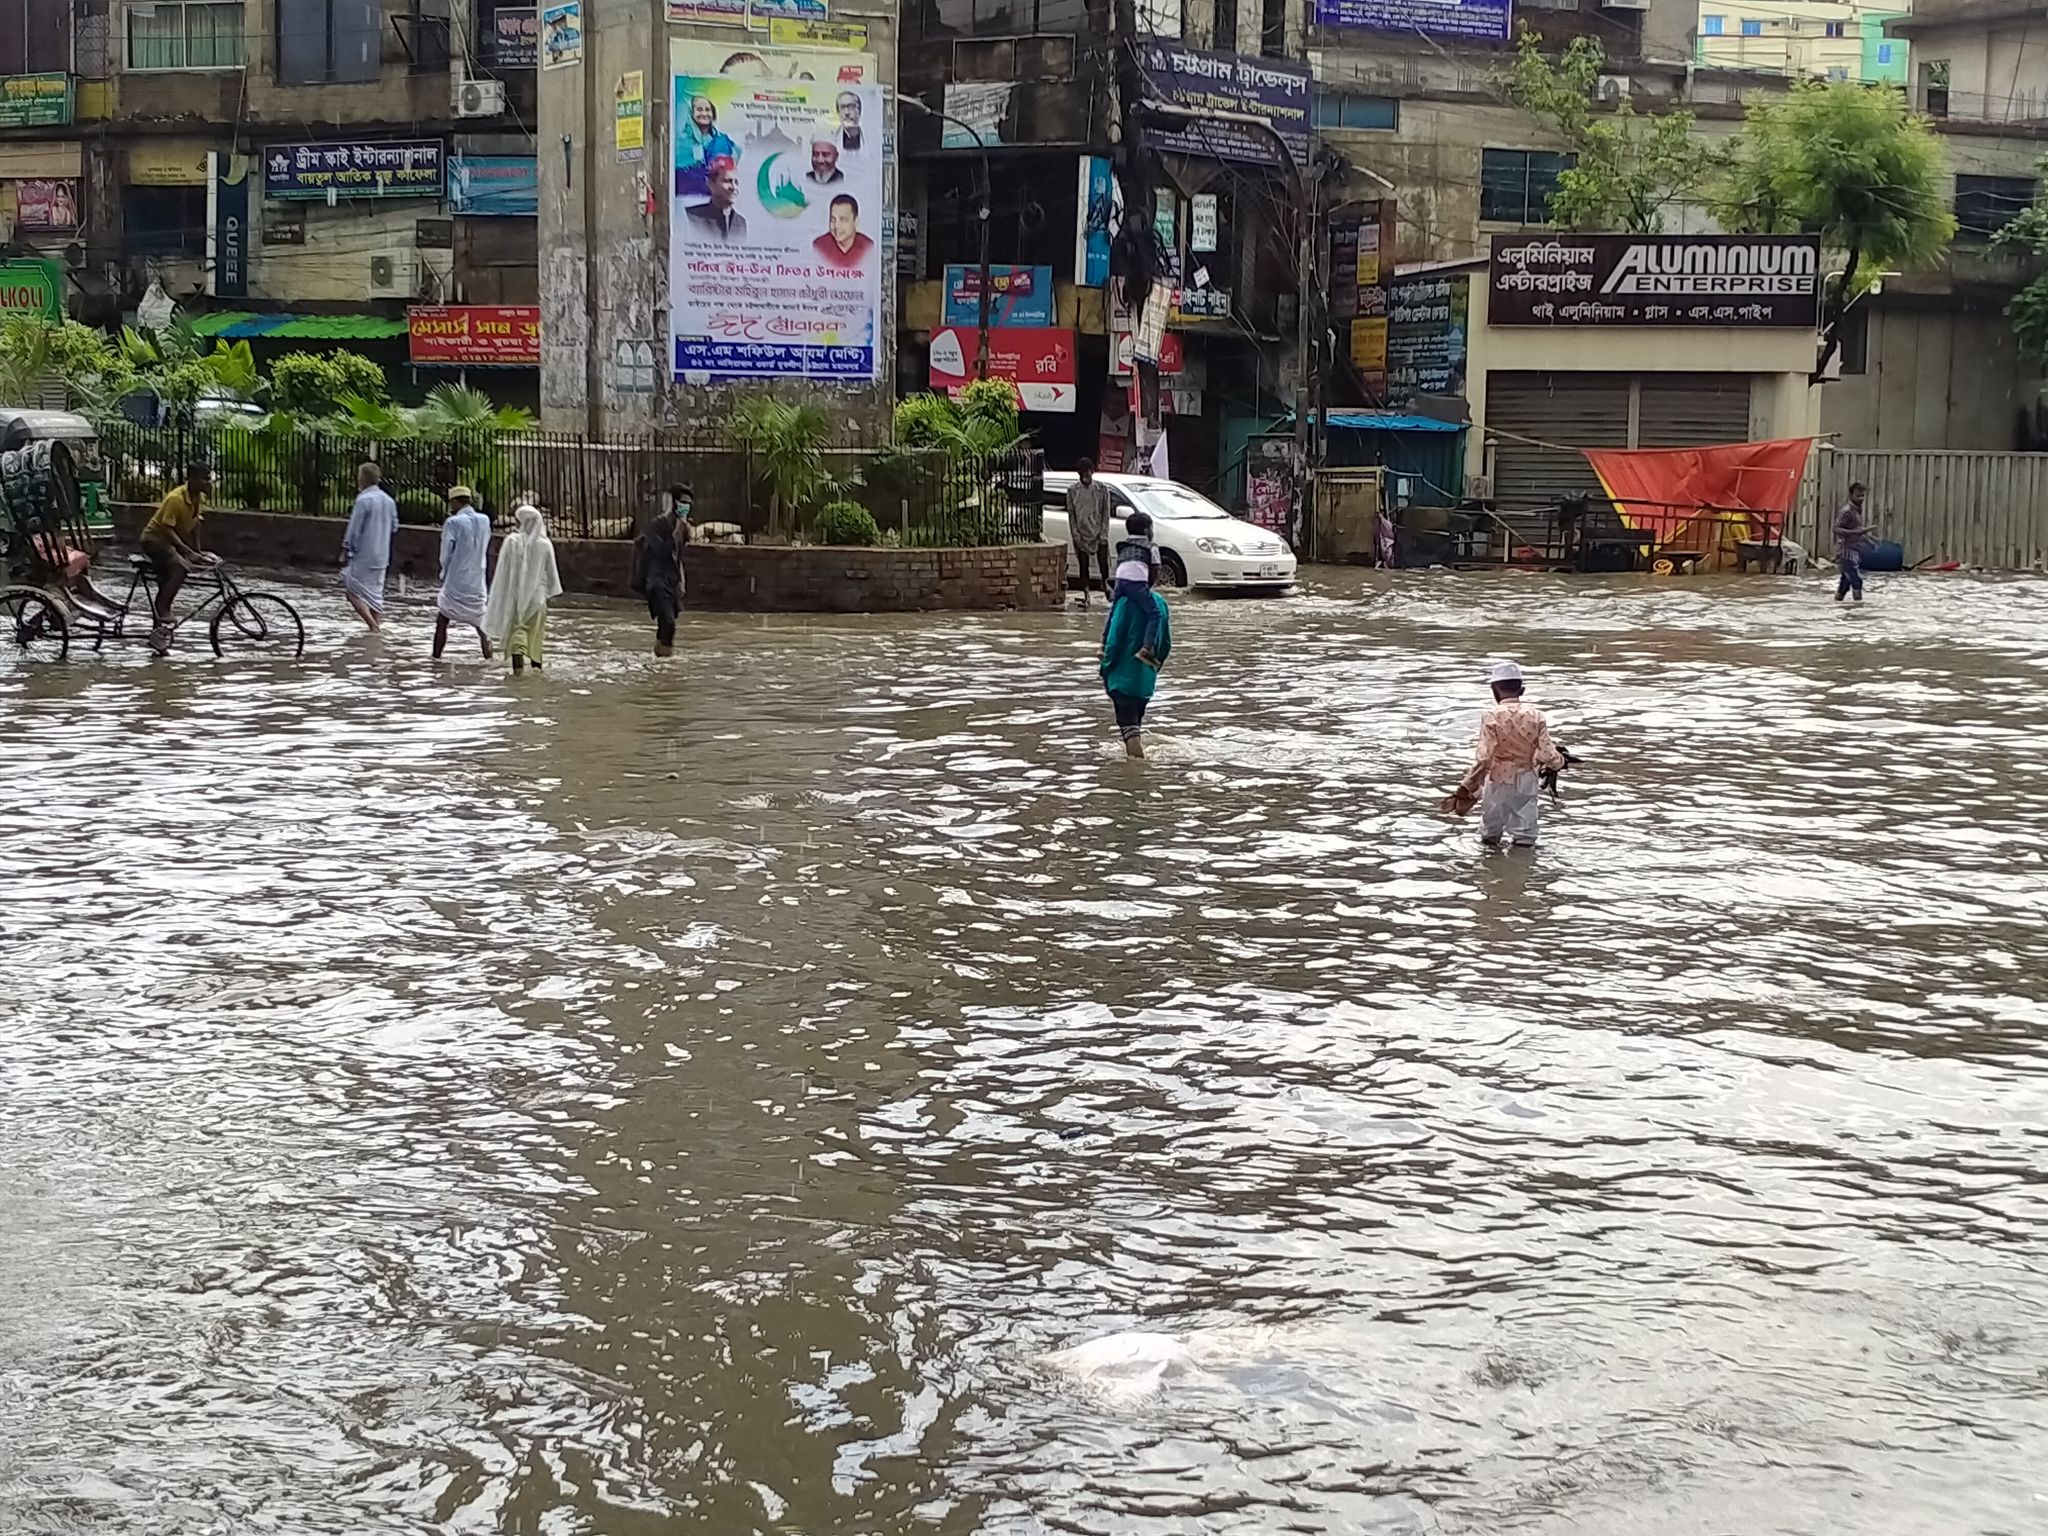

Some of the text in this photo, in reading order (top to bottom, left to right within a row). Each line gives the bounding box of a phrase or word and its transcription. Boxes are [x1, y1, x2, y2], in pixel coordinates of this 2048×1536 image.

[1171, 49, 1233, 81] চট্টগ্রাম
[295, 145, 438, 169] ড্রীম স্কাই ইন্টারন্যাশনাল
[297, 172, 333, 186] বায়তুল
[335, 167, 372, 183] আতিক
[397, 168, 437, 183] কাফেলা
[1497, 241, 1595, 269] এলুমিনিয়াম
[687, 261, 720, 273] পবিত্র
[1599, 245, 1816, 293] ALUMINIUM
[1496, 270, 1594, 293] এন্টারপ্রাইজ
[1635, 277, 1813, 291] ENTERPRISE
[1532, 301, 1555, 321] থাই
[1559, 302, 1625, 321] এলুমিনিয়াম
[1645, 305, 1668, 320] গ্লাস
[411, 312, 469, 336] মেসার্স
[475, 319, 511, 335] সান
[706, 309, 764, 340] ঈদ
[736, 344, 787, 359] শফিউল
[1035, 354, 1057, 375] রবি
